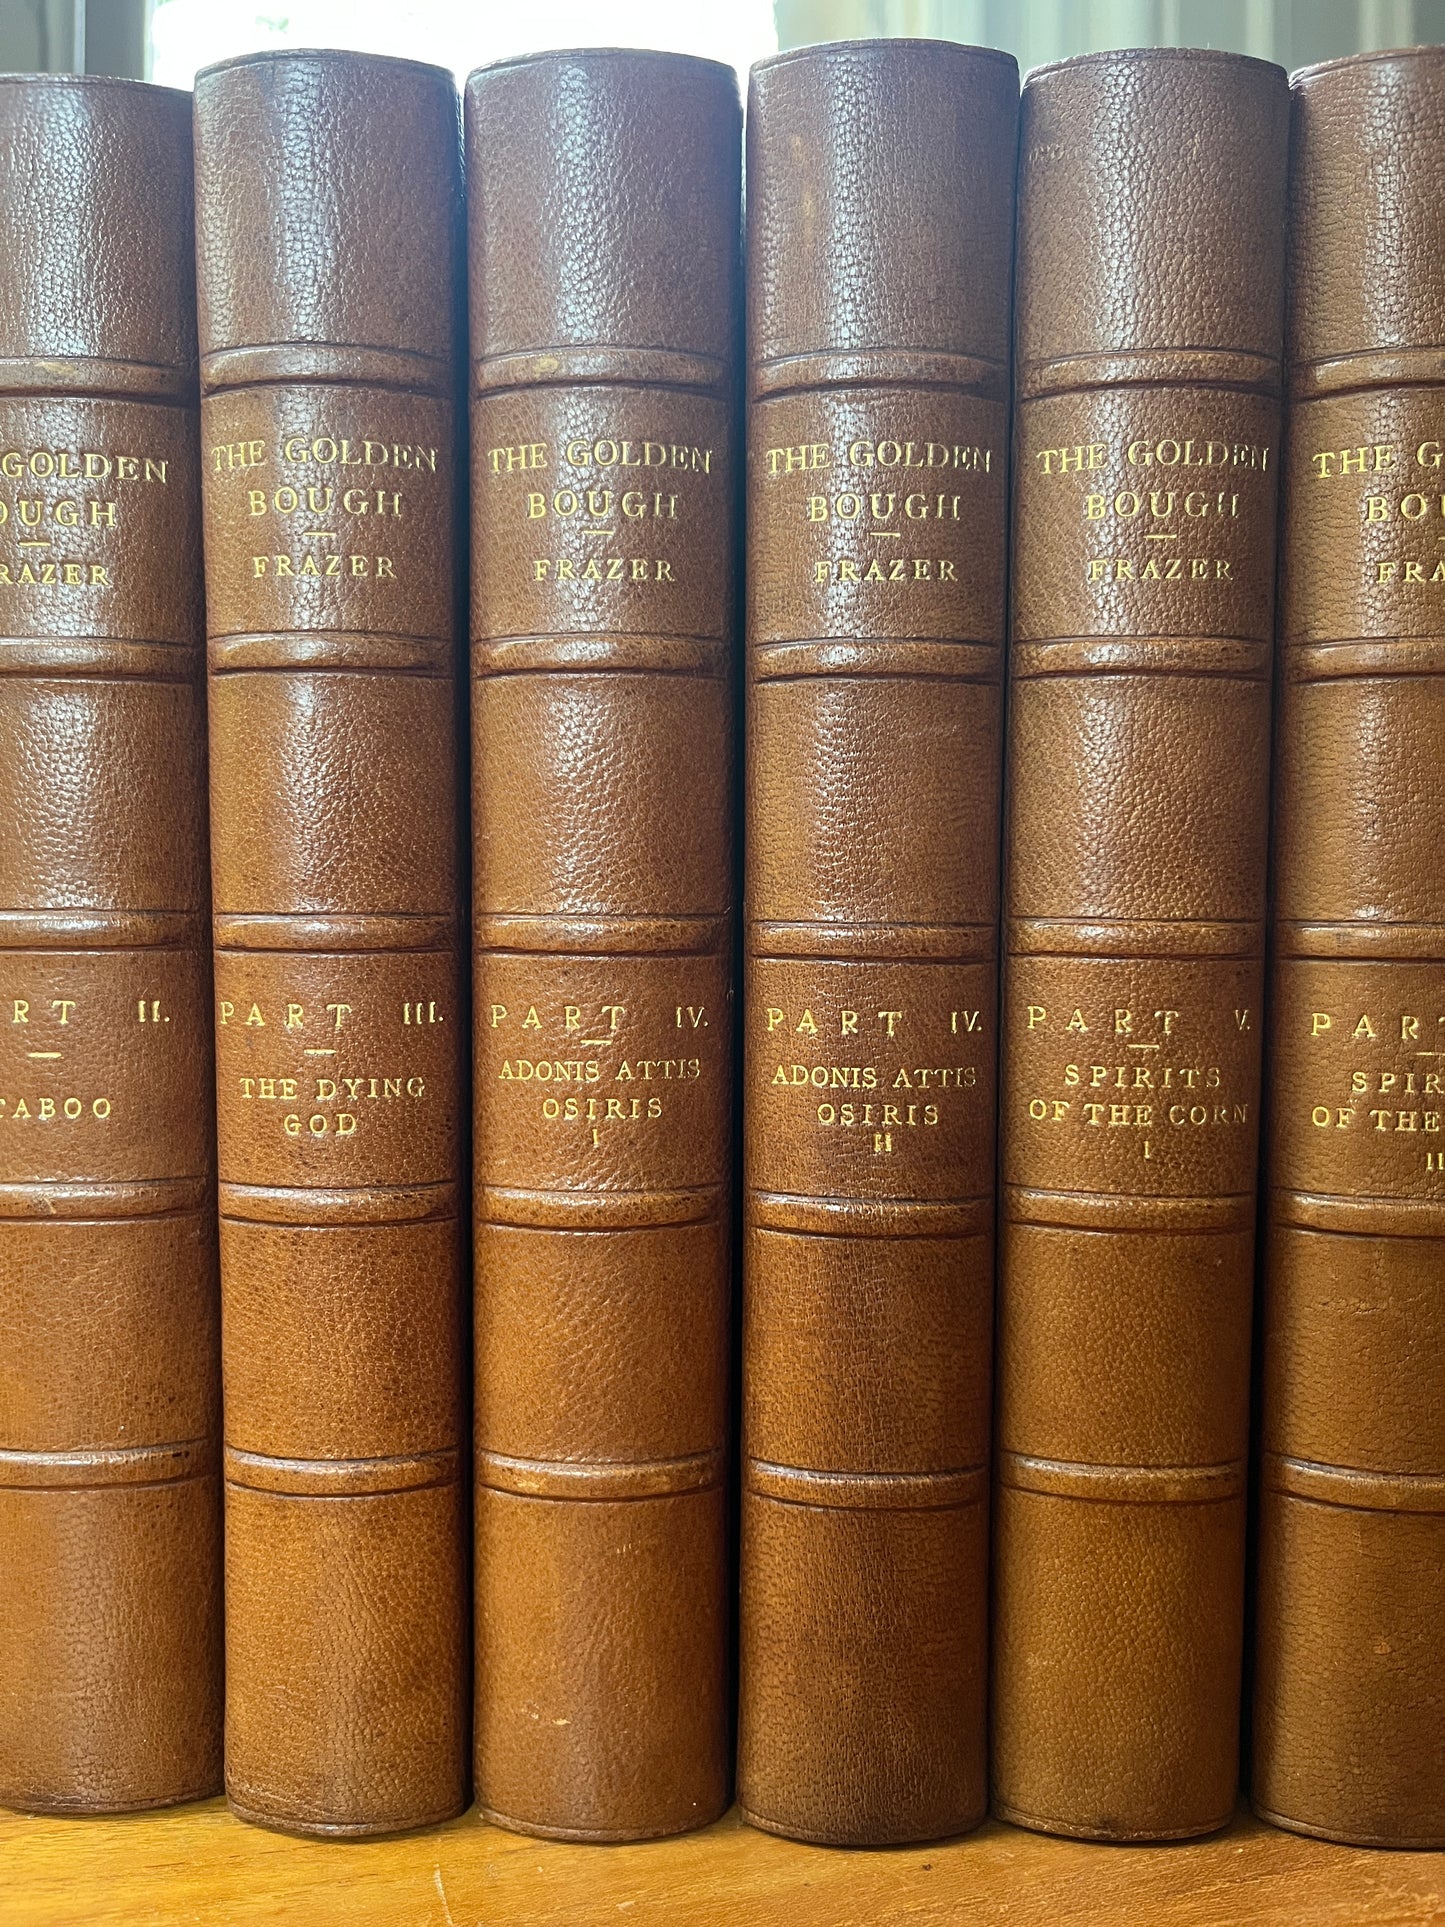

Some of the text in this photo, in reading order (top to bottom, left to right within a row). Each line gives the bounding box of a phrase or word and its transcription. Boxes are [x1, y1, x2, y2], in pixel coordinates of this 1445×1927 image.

[211, 437, 438, 472] THE GOLDEN
[488, 440, 713, 475] THE GOLDEN
[766, 440, 991, 476] THE GOLDEN
[1036, 440, 1270, 475] THE GOLDEN
[1312, 445, 1396, 479] THE
[2, 452, 168, 484] GOLDEN
[248, 487, 402, 518] BOUGH
[528, 490, 678, 520] BOUGH
[809, 492, 961, 523] BOUGH
[1085, 491, 1240, 520] BOUGH
[1366, 493, 1445, 522] BO
[252, 555, 397, 578] FRAZER
[533, 559, 675, 582] FRAZER
[814, 560, 958, 583] FRAZER
[1089, 559, 1233, 581] FRAZER
[138, 1000, 170, 1022] II.
[220, 1001, 444, 1027] PART III.
[491, 1006, 709, 1031] PART IV.
[767, 1008, 983, 1036] PART IV.
[1027, 1006, 1179, 1035] PART
[1310, 1012, 1445, 1040] PAR
[499, 1058, 700, 1081] ADONIS ATTIS
[771, 1066, 976, 1088] ADONIS ATTIS
[1065, 1064, 1220, 1089] SPIRITS
[240, 1077, 425, 1100] THE DYING
[0, 1098, 111, 1120] ABOO
[542, 1098, 662, 1121] OSIRIS
[818, 1103, 938, 1125] OSIRIS
[1029, 1099, 1248, 1126] OF THE CORN
[1312, 1106, 1440, 1132] OF THE
[284, 1114, 357, 1136] GOD
